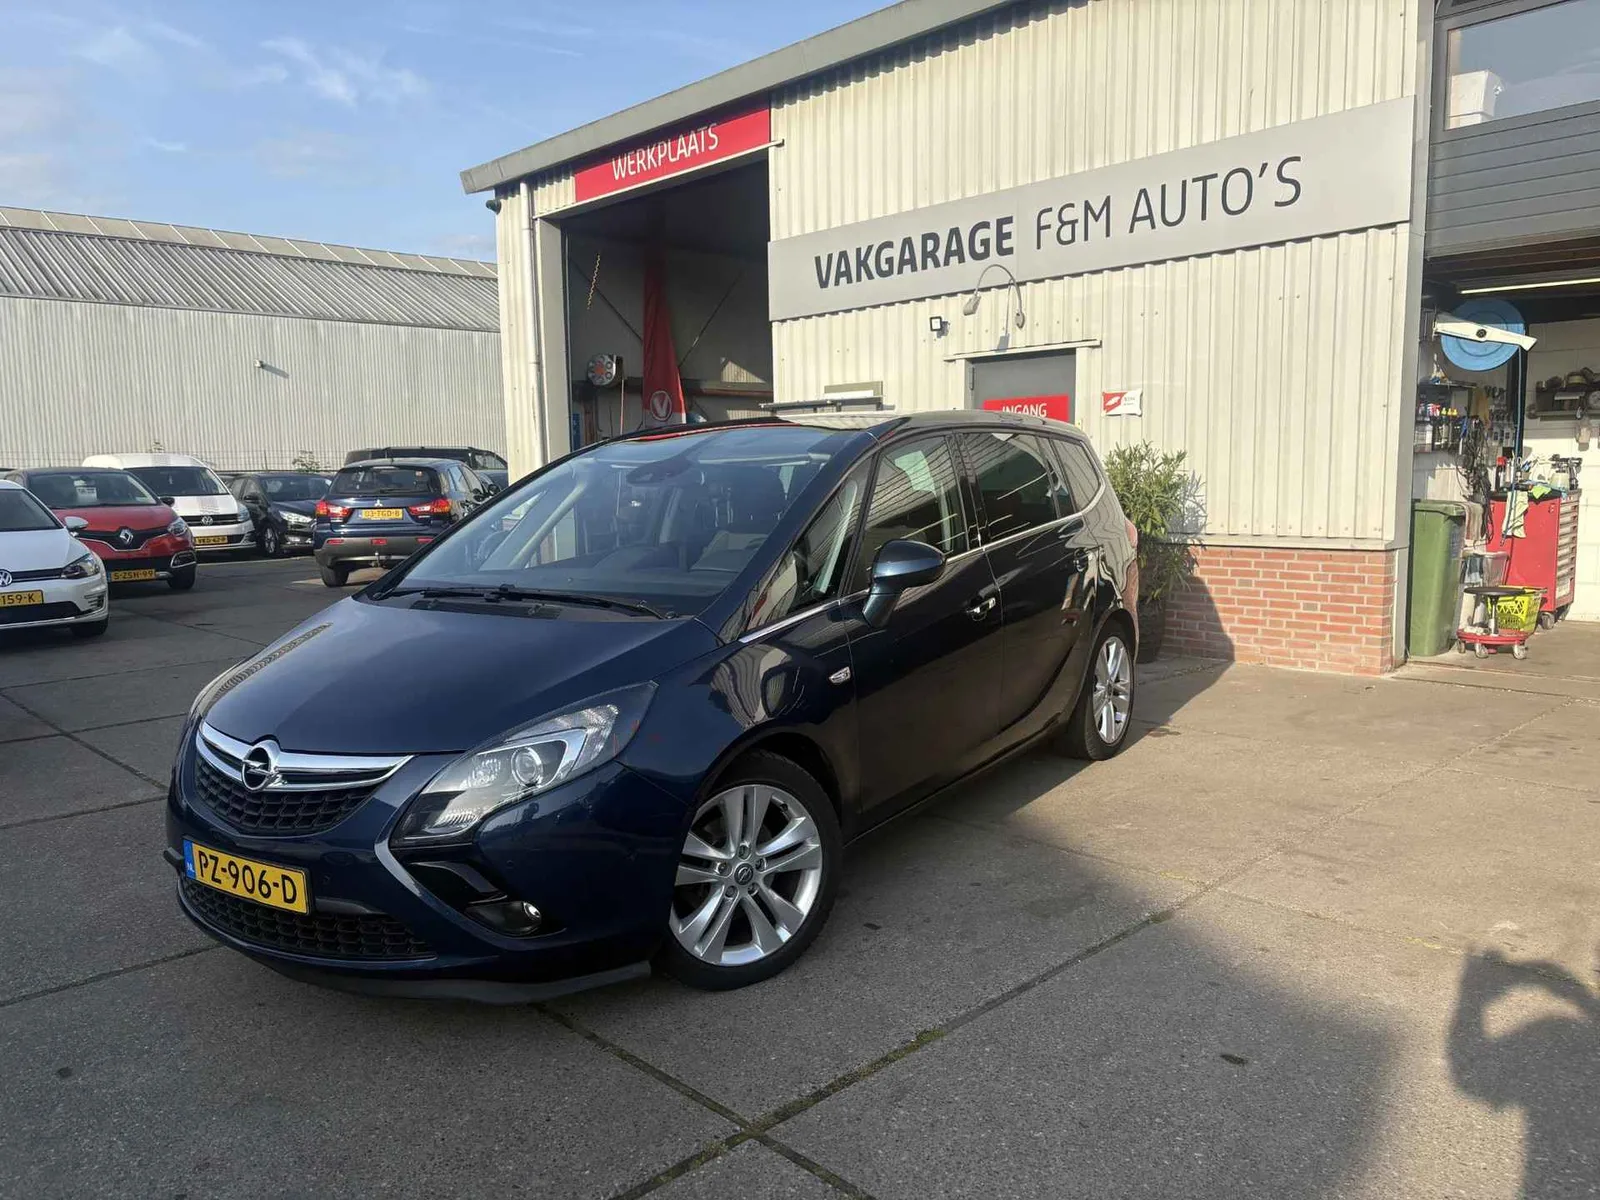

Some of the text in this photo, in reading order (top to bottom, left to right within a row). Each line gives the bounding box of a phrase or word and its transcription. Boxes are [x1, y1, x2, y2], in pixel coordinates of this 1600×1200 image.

[611, 122, 719, 181] WERKPLAATS
[814, 156, 1302, 290] VAKGARAGE F&M AUTO'S
[198, 850, 297, 904] PZ-906-D
